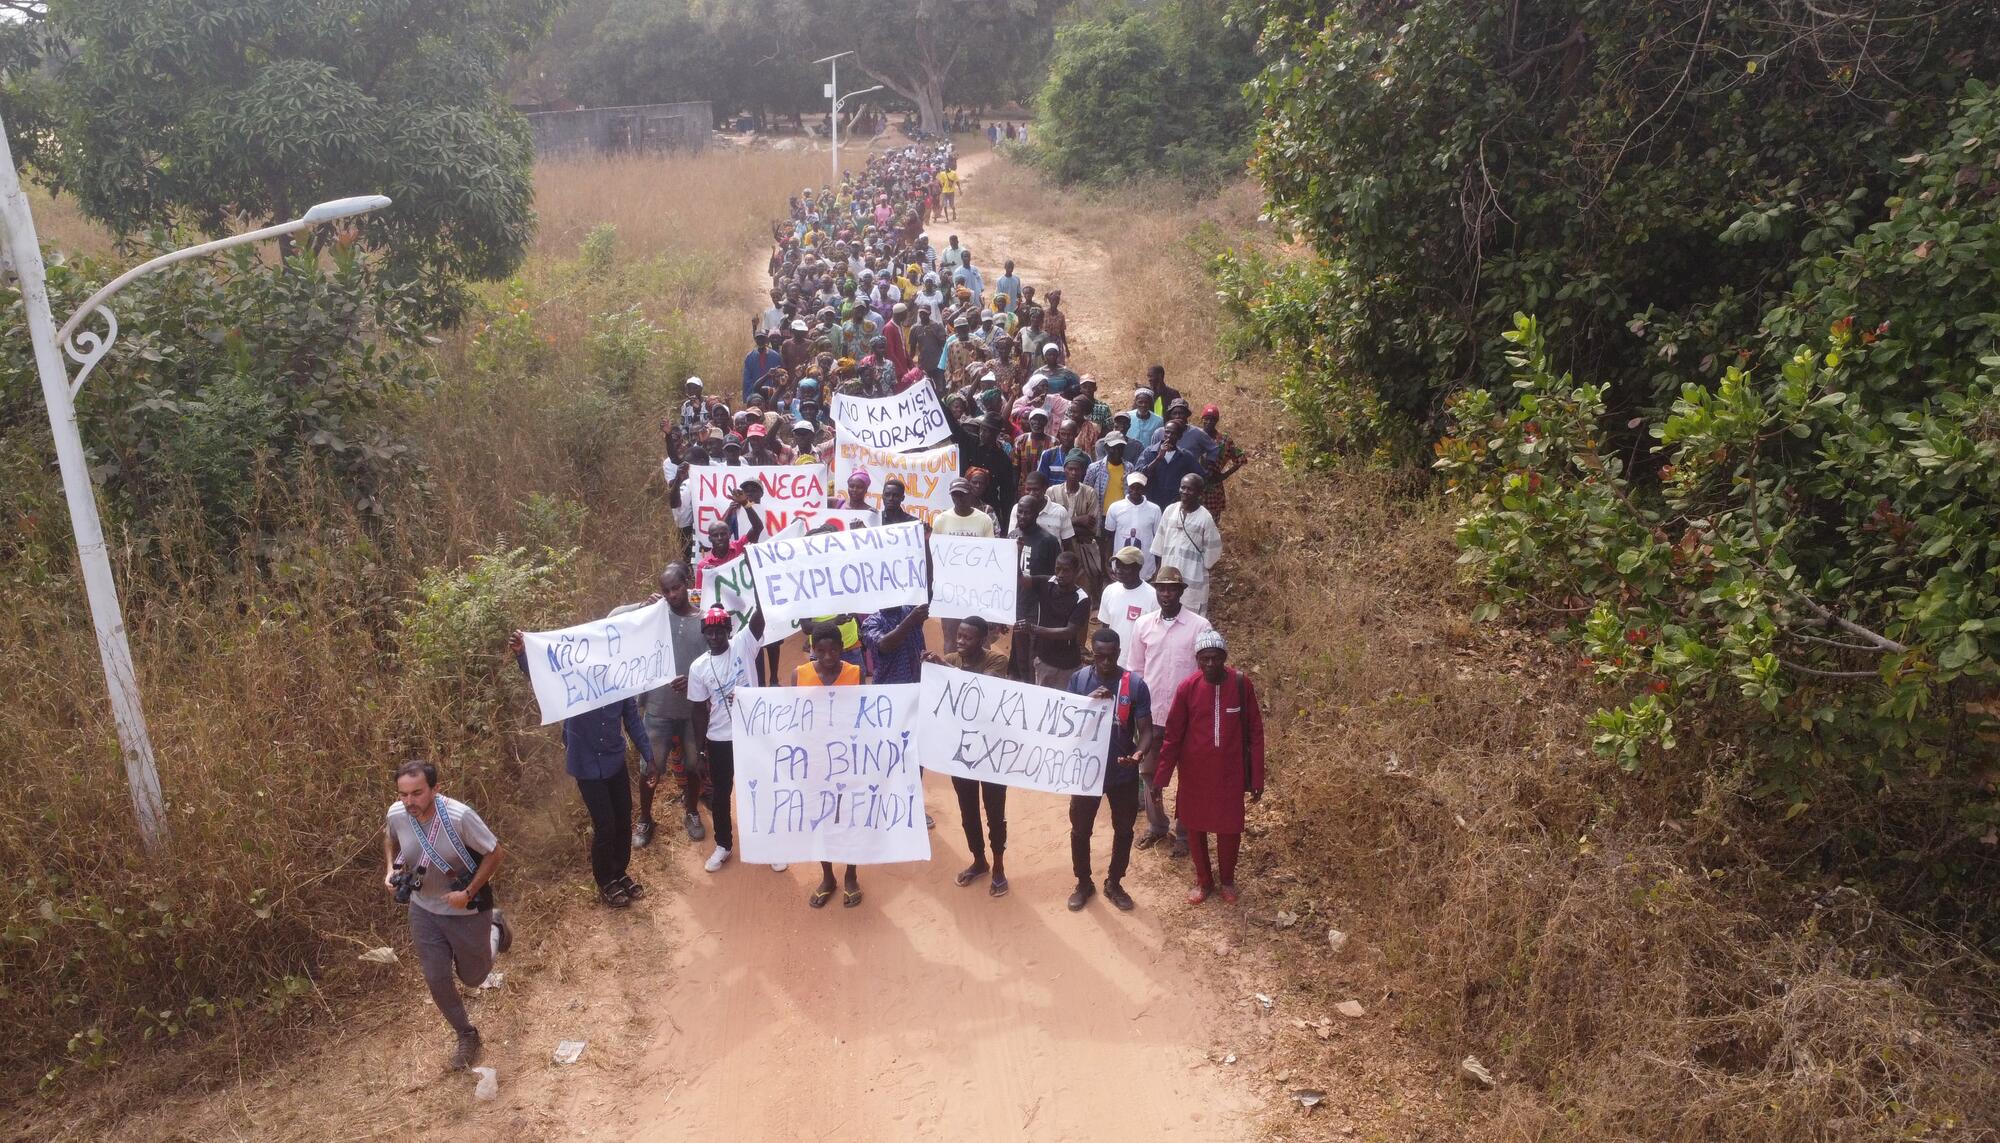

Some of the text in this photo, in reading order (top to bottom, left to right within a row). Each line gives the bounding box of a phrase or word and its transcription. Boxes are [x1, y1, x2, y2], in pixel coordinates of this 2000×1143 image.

[838, 400, 860, 422] NO
[866, 405, 892, 424] KA
[758, 471, 824, 500] NEGA
[753, 524, 924, 569] NO KA MISTI
[547, 624, 621, 672] NÃO A
[854, 694, 893, 728] KA
[992, 689, 1028, 730] KA
[773, 744, 808, 783] PA
[952, 729, 1100, 792] EXPLORAÇÃO
[768, 789, 804, 834] PA
